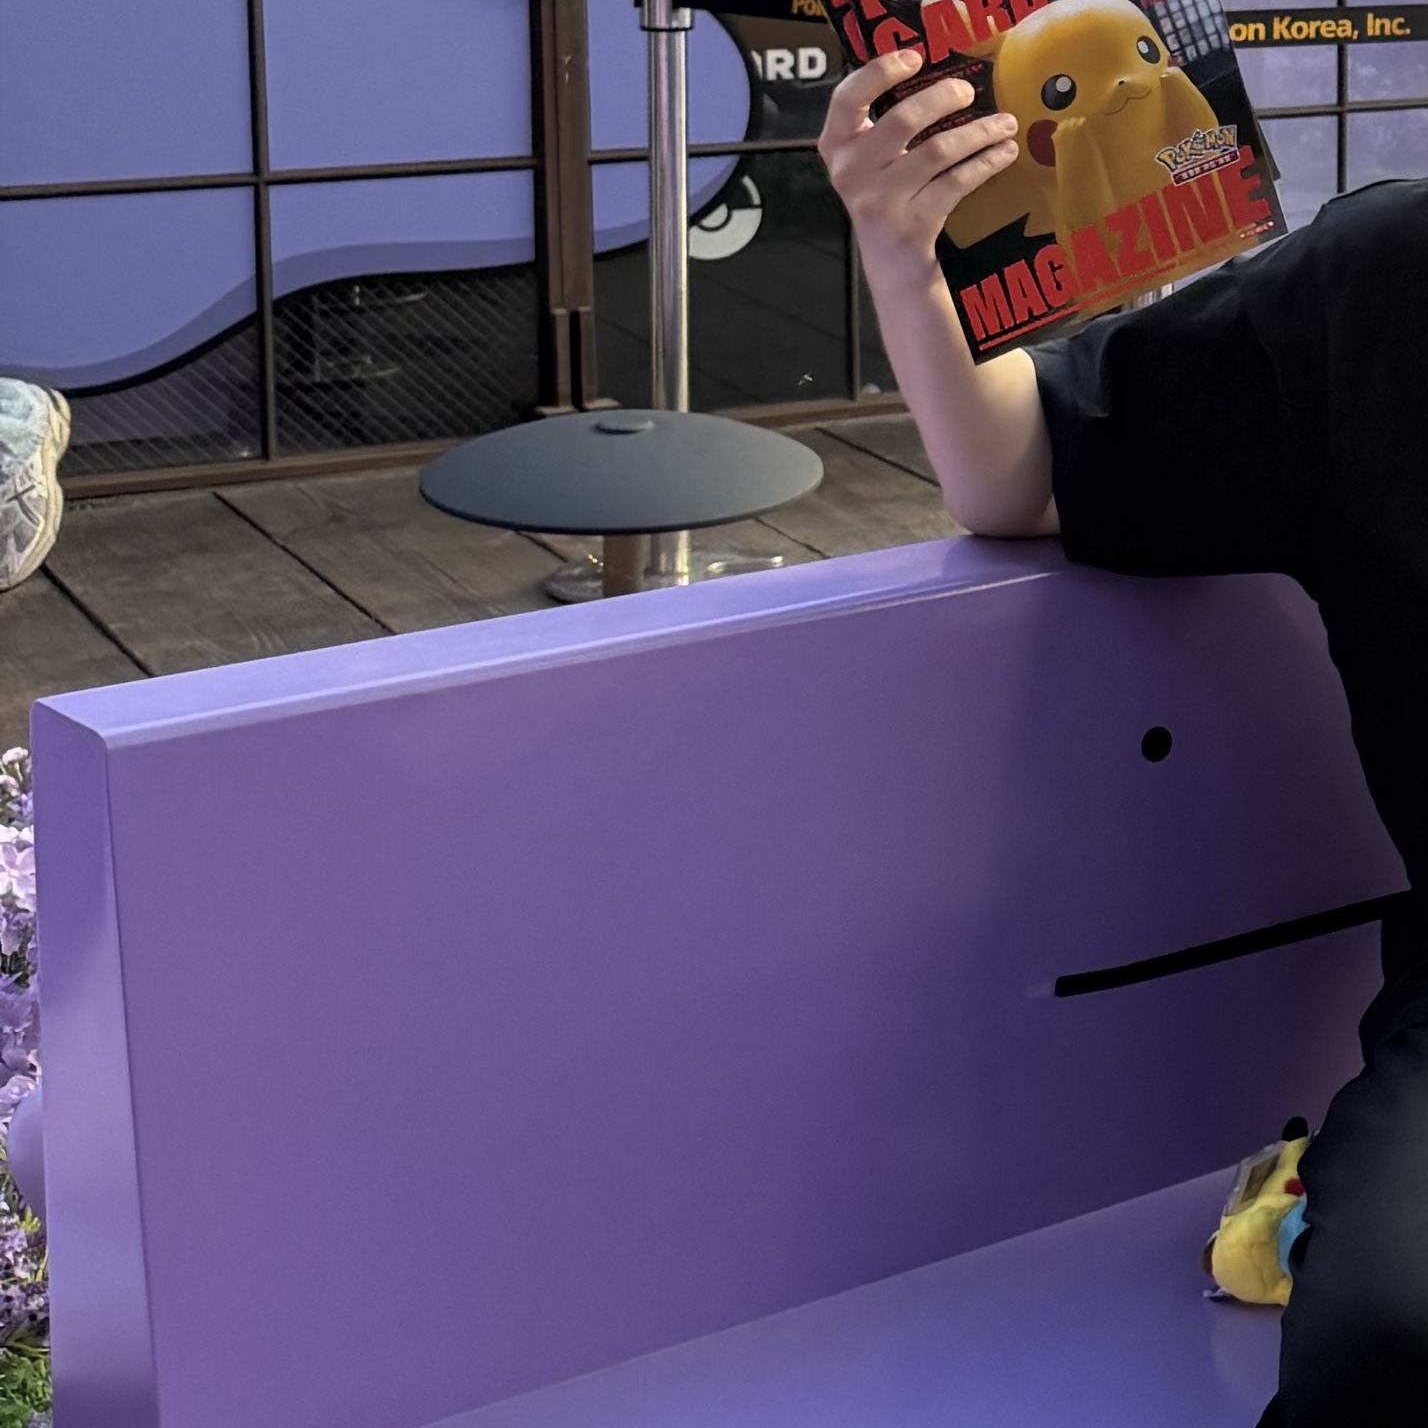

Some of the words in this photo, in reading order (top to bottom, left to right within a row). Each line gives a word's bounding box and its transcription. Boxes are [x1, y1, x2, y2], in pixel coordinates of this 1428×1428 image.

[1273, 15, 1359, 41] Korea,
[1367, 12, 1411, 38] Inc.
[960, 145, 1272, 340] MAGAZINE
